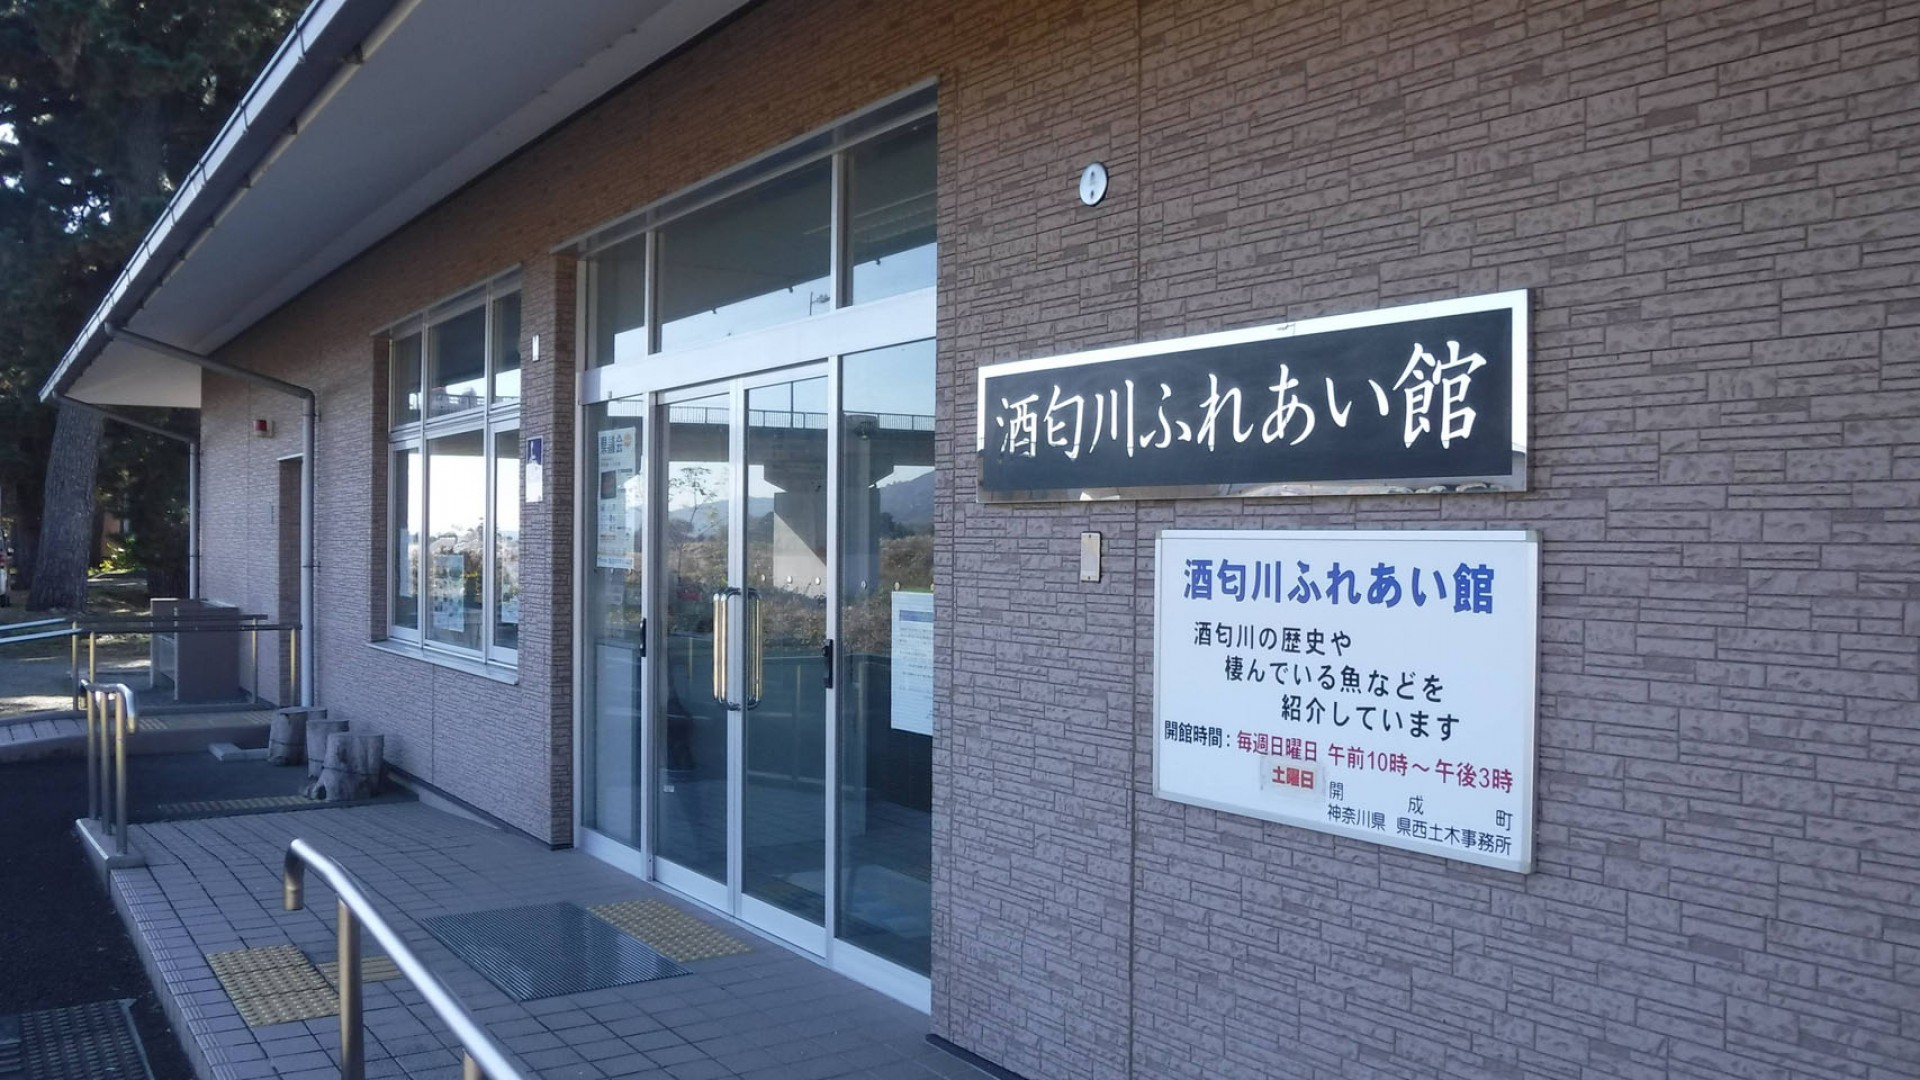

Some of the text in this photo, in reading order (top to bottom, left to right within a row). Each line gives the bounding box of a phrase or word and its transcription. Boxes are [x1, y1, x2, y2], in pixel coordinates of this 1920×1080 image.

[996, 341, 1486, 460] 酒匂川ふれあい館
[1183, 559, 1495, 614] 酒匂川ふれあい館
[1193, 621, 1352, 656] 酒匂川の歴史や
[1225, 655, 1444, 702] 棲んでいる魚などを
[1281, 694, 1460, 741] 紹介しています
[1272, 766, 1314, 789] 土曜日
[1327, 803, 1512, 855] 神奈川県 県西土木事務所
